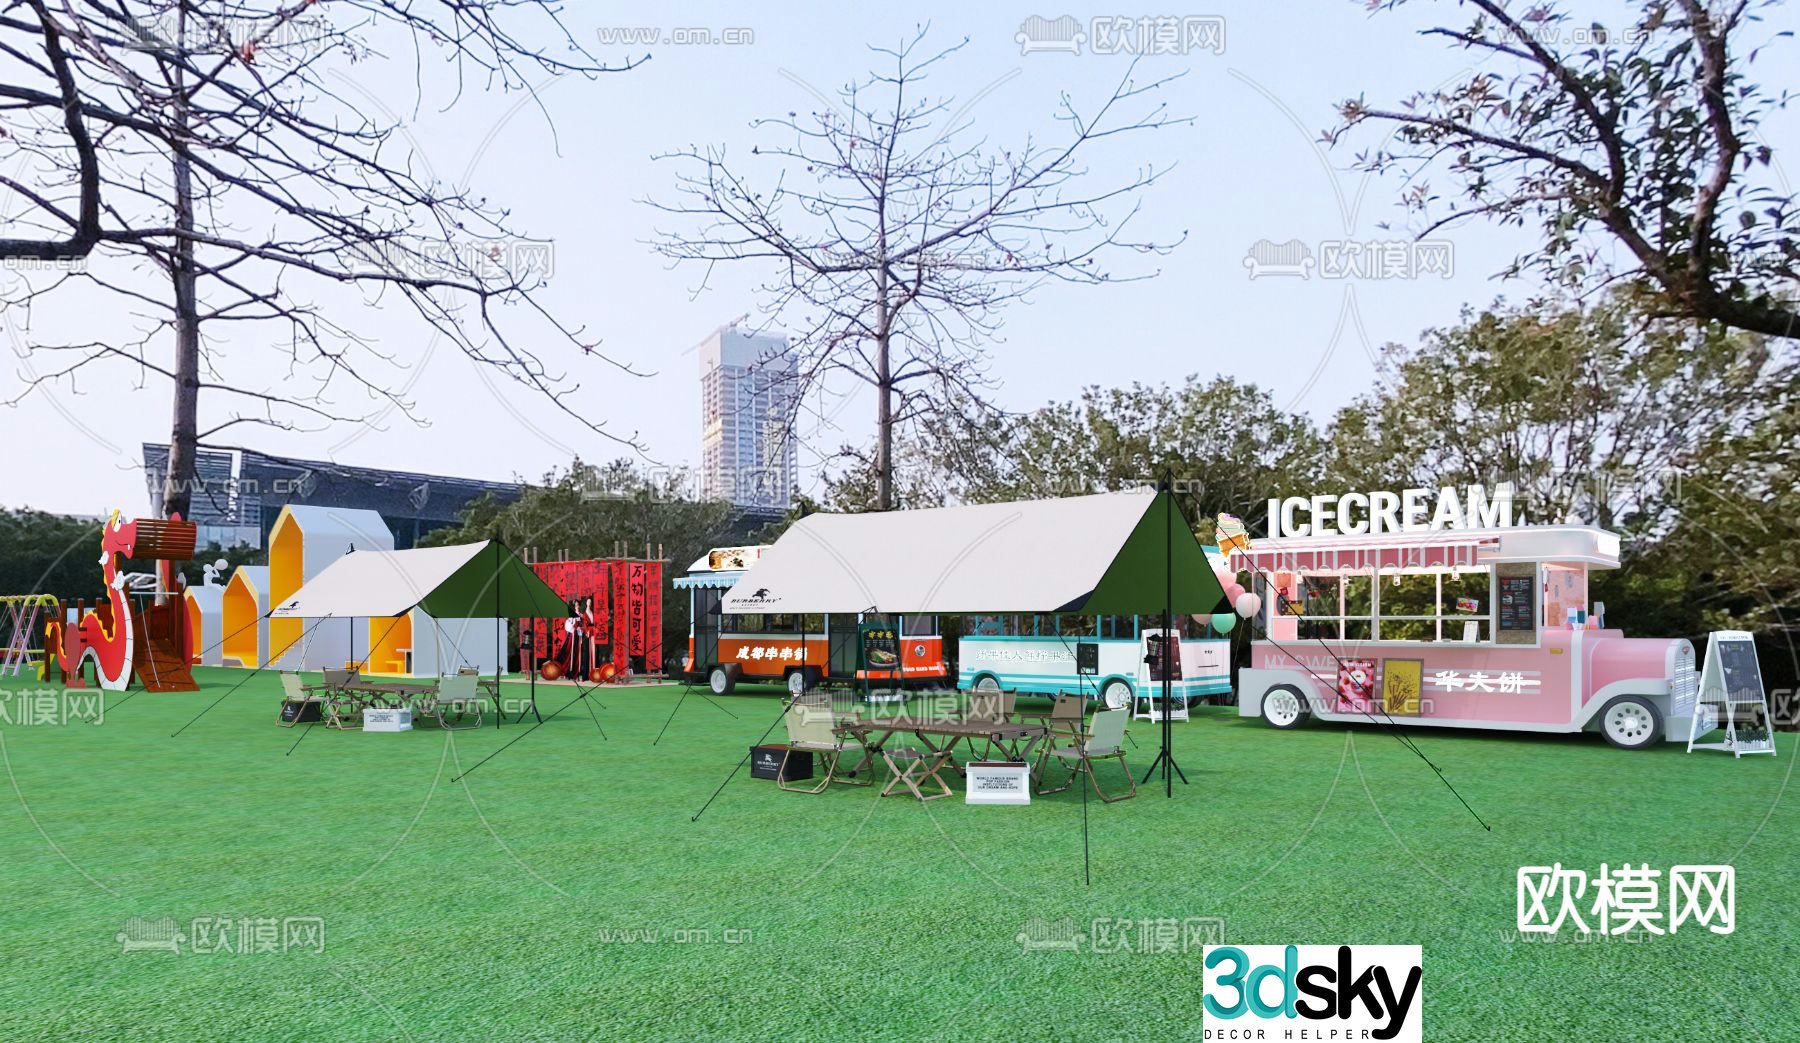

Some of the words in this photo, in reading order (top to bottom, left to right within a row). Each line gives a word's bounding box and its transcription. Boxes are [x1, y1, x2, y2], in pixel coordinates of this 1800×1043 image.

[1267, 481, 1516, 538] ICECREAM
[1435, 670, 1524, 694] 华夫饼
